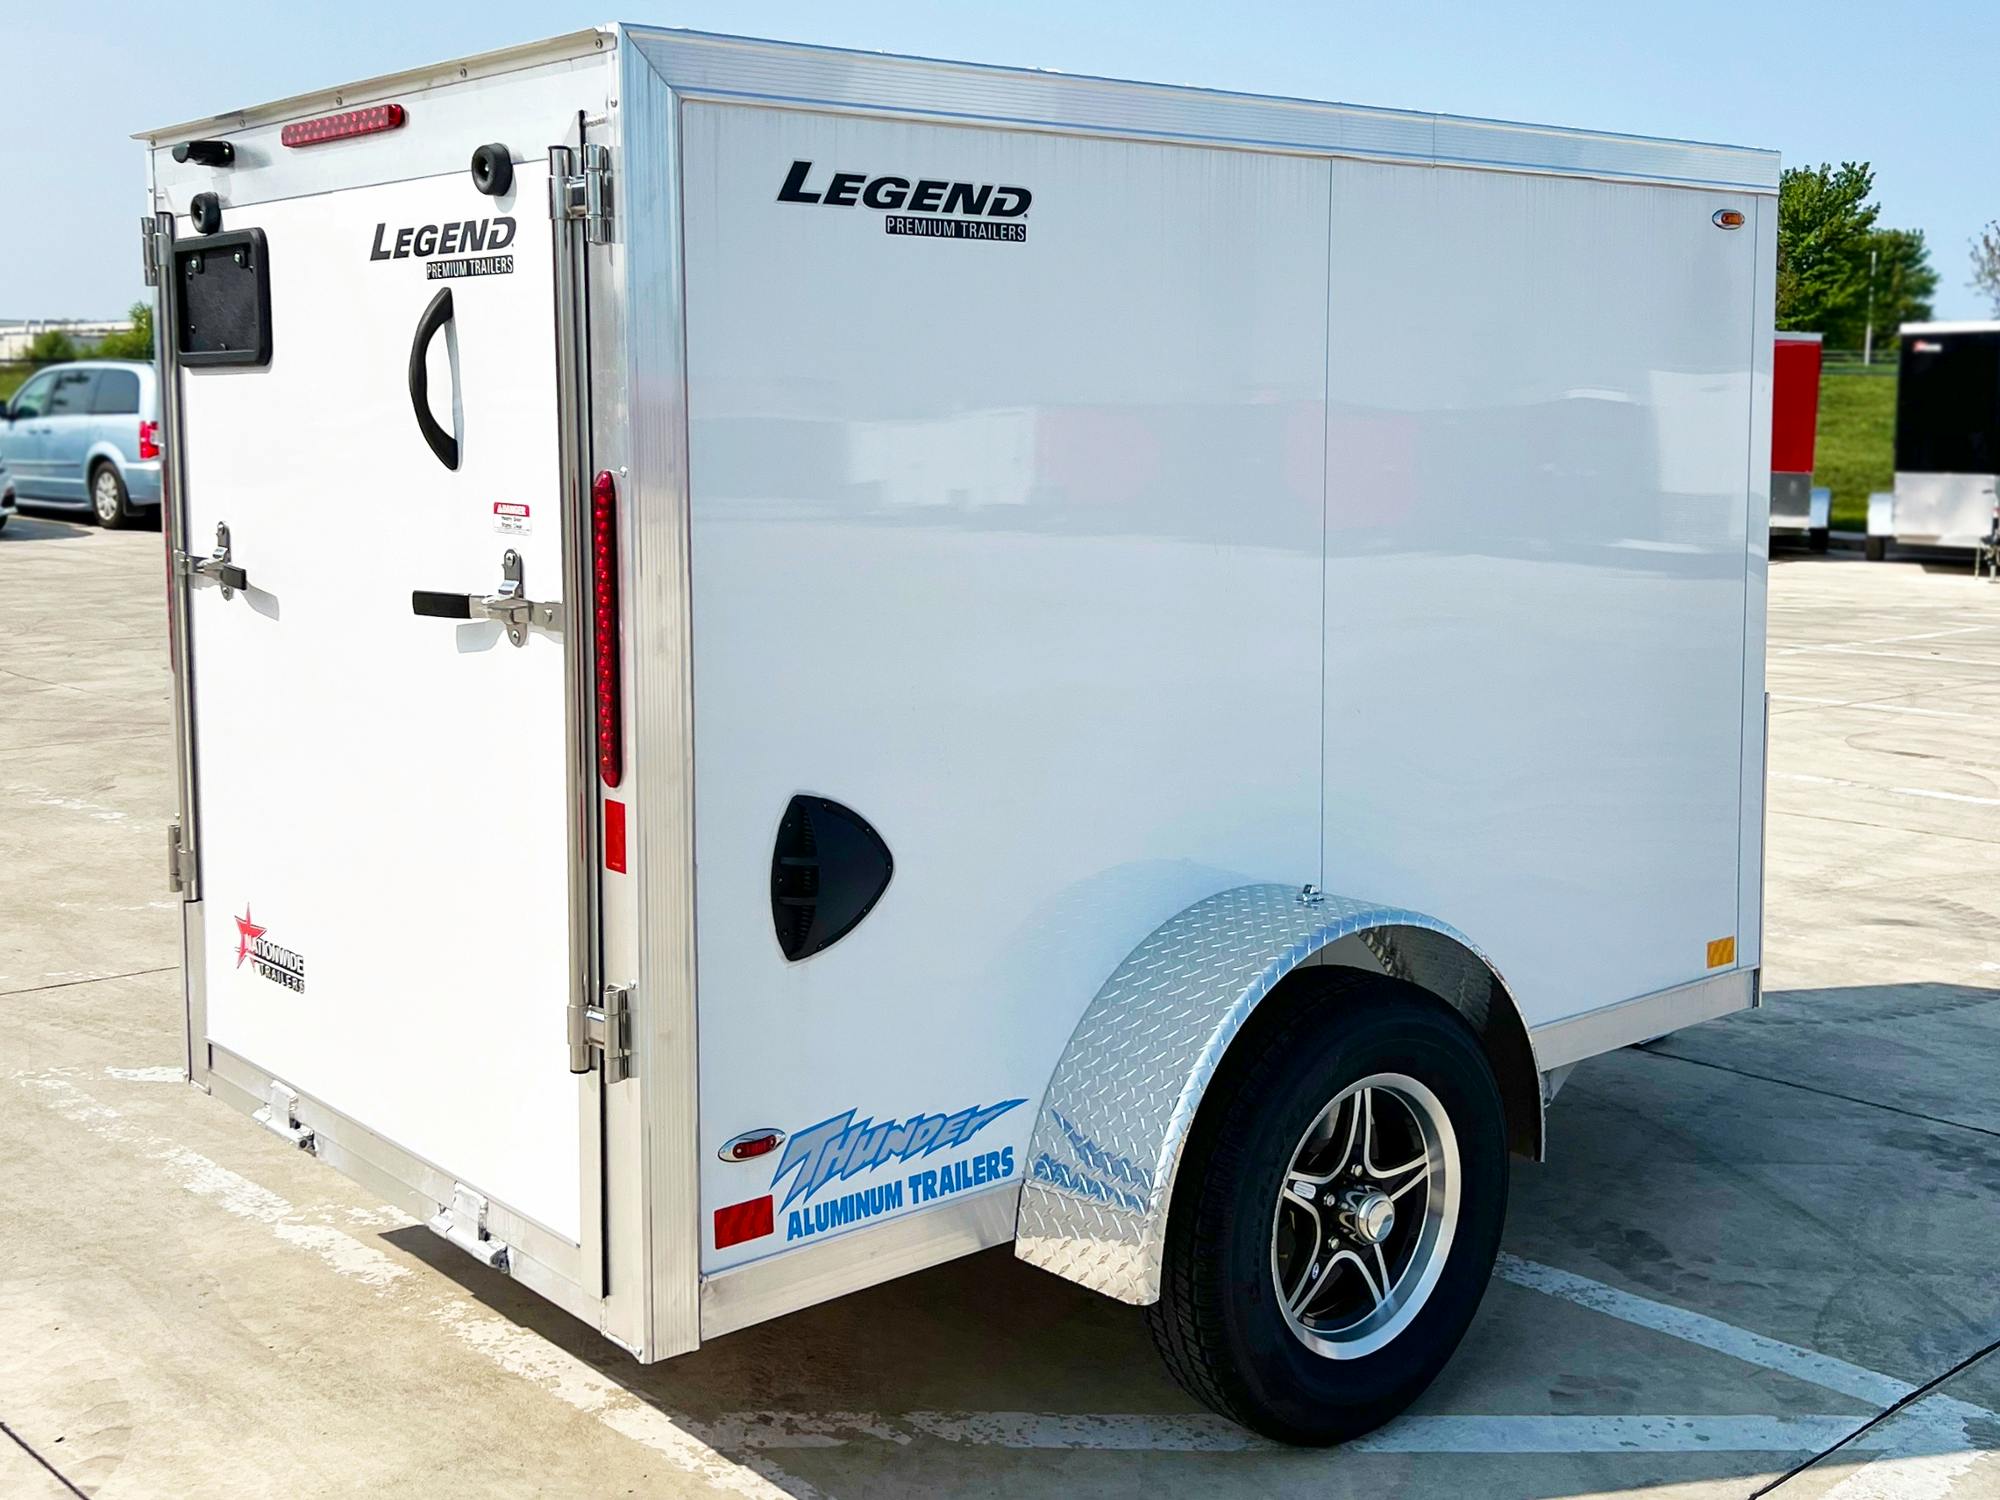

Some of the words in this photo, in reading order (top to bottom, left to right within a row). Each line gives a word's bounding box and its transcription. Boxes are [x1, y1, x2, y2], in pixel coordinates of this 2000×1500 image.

[776, 160, 1033, 218] LEGEND
[370, 216, 517, 261] LEGEND
[886, 217, 956, 237] PREMIUM
[960, 222, 1026, 242] TRAILERS
[426, 261, 468, 279] PREMIUM
[470, 256, 513, 275] TRAILERS
[259, 964, 304, 995] TRAILERS
[769, 1098, 1030, 1216] THUNDER
[787, 1180, 903, 1242] ALUMINUM
[908, 1146, 1014, 1205] TRAILERS
